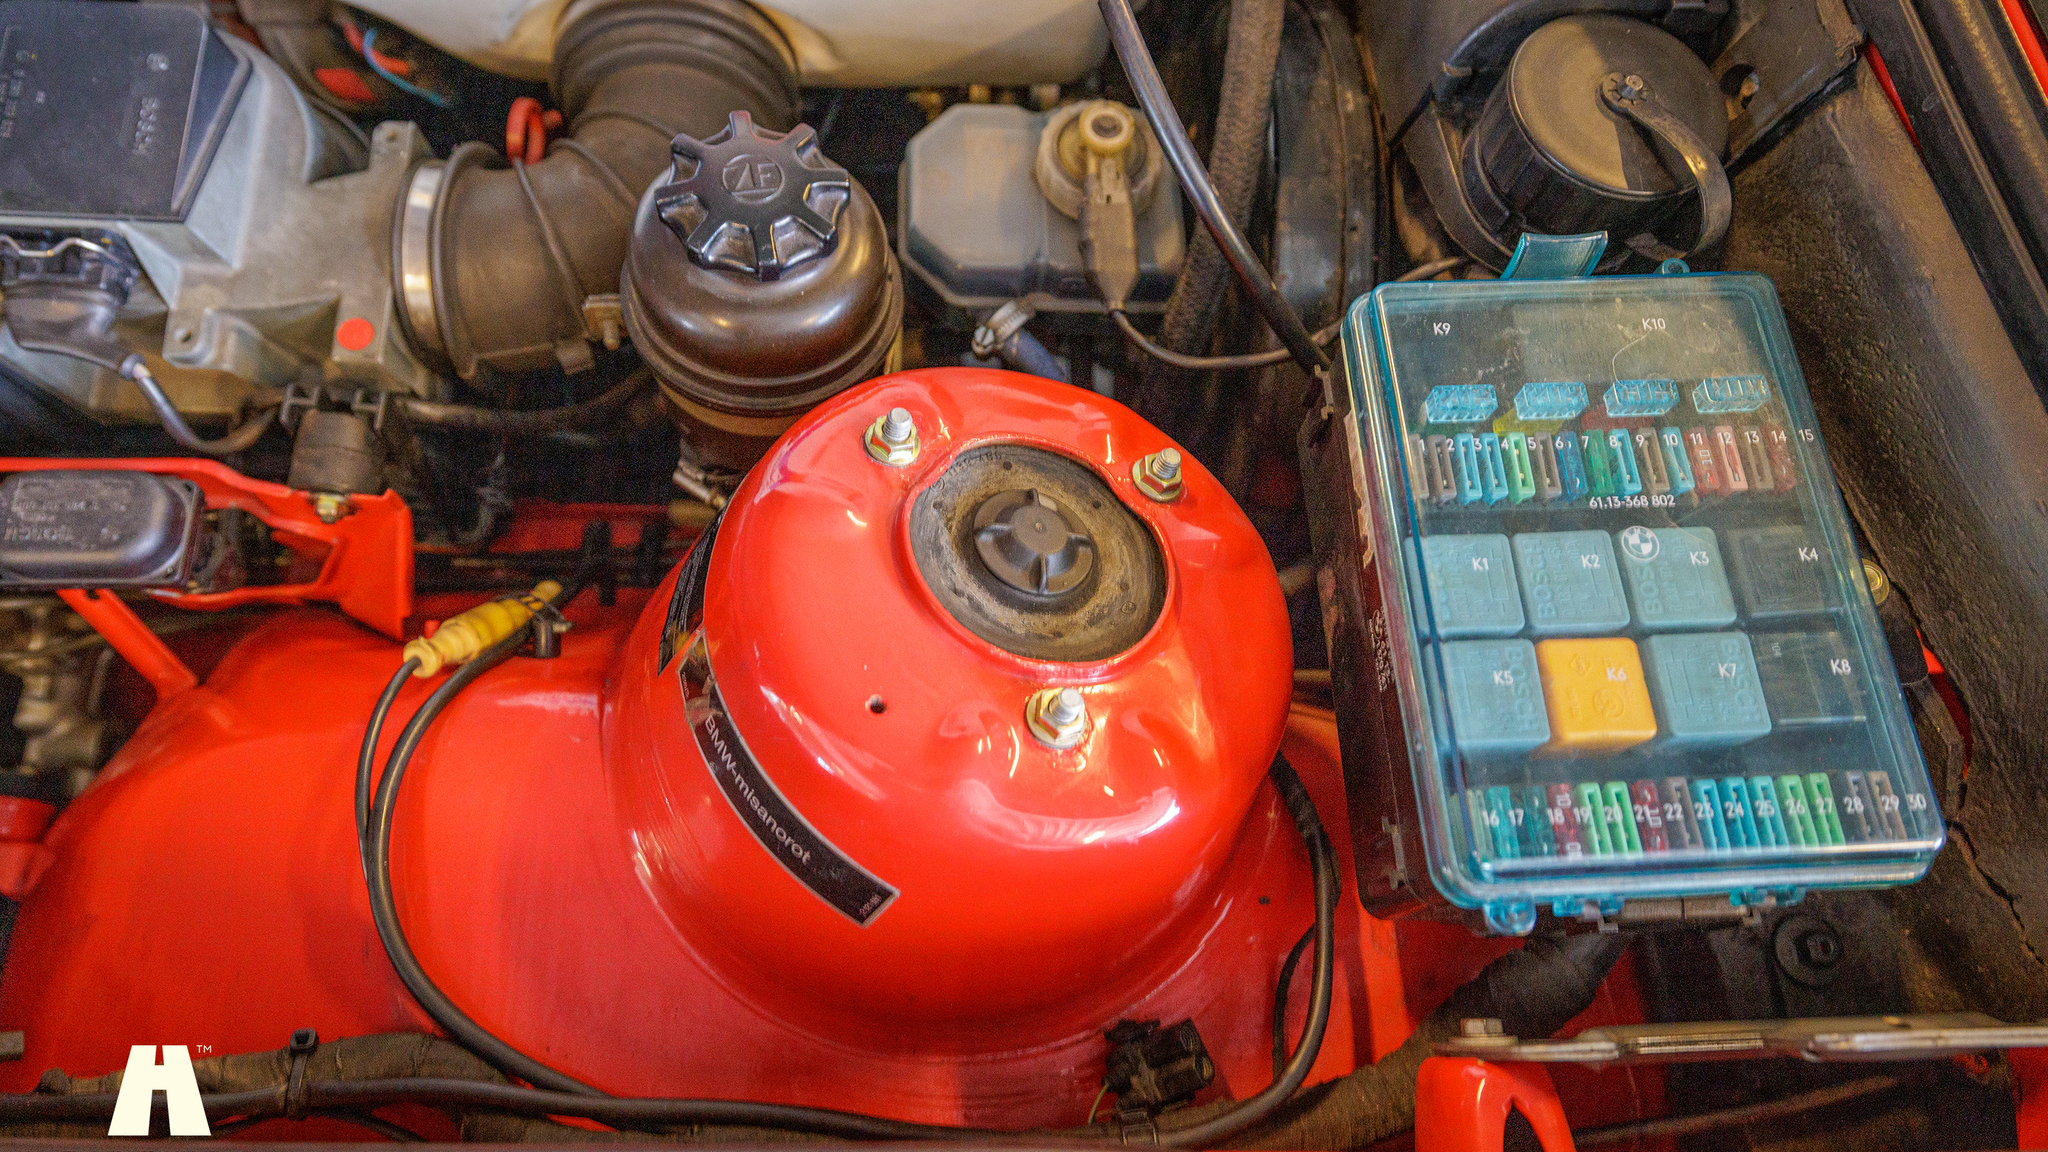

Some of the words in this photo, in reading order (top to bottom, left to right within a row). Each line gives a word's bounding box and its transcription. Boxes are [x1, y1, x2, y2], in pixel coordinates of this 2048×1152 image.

[1433, 322, 1451, 336] K9
[1642, 318, 1667, 331] K10
[1419, 439, 1426, 452] 1
[1446, 438, 1456, 451] 2
[1473, 437, 1482, 450] 3
[1501, 437, 1509, 450] 4
[1528, 437, 1537, 449] 5
[1555, 436, 1564, 449] 6
[1582, 435, 1590, 448] 7
[1609, 435, 1618, 448] 8
[1635, 434, 1645, 448] 9
[1663, 433, 1679, 447] 10
[1690, 432, 1703, 446] 11
[1717, 431, 1733, 445] 12
[1744, 430, 1760, 443] 13
[1771, 430, 1787, 443] 14
[1798, 429, 1814, 442] 15
[1589, 495, 1649, 509] 61.13-368
[1651, 494, 1676, 508] 802
[1472, 557, 1489, 571] K1
[1581, 554, 1601, 569] K2
[1690, 551, 1710, 565] K3
[1798, 547, 1819, 562] K4
[1522, 539, 1557, 620] BOSCH
[1637, 566, 1664, 615] BOS
[1493, 670, 1513, 686] K5
[1606, 667, 1627, 682] K6
[1718, 663, 1736, 678] K7
[1830, 658, 1851, 676] K8
[1505, 647, 1539, 732] BOSCH
[705, 715, 812, 864] BMW-misanorot
[1483, 810, 1499, 826] 16
[1508, 809, 1524, 825] 17
[1547, 808, 1565, 825] 18
[1573, 807, 1590, 822] 19
[1604, 807, 1624, 822] 20
[1634, 804, 1651, 822] 21
[1664, 803, 1684, 820] 22
[1694, 802, 1714, 820] 23
[1724, 801, 1744, 818] 24
[1755, 799, 1775, 817] 25
[1785, 798, 1805, 815] 26
[1815, 797, 1834, 814] 27
[1844, 796, 1864, 814] 28
[1881, 795, 1900, 813] 29
[1907, 793, 1927, 811] 30
